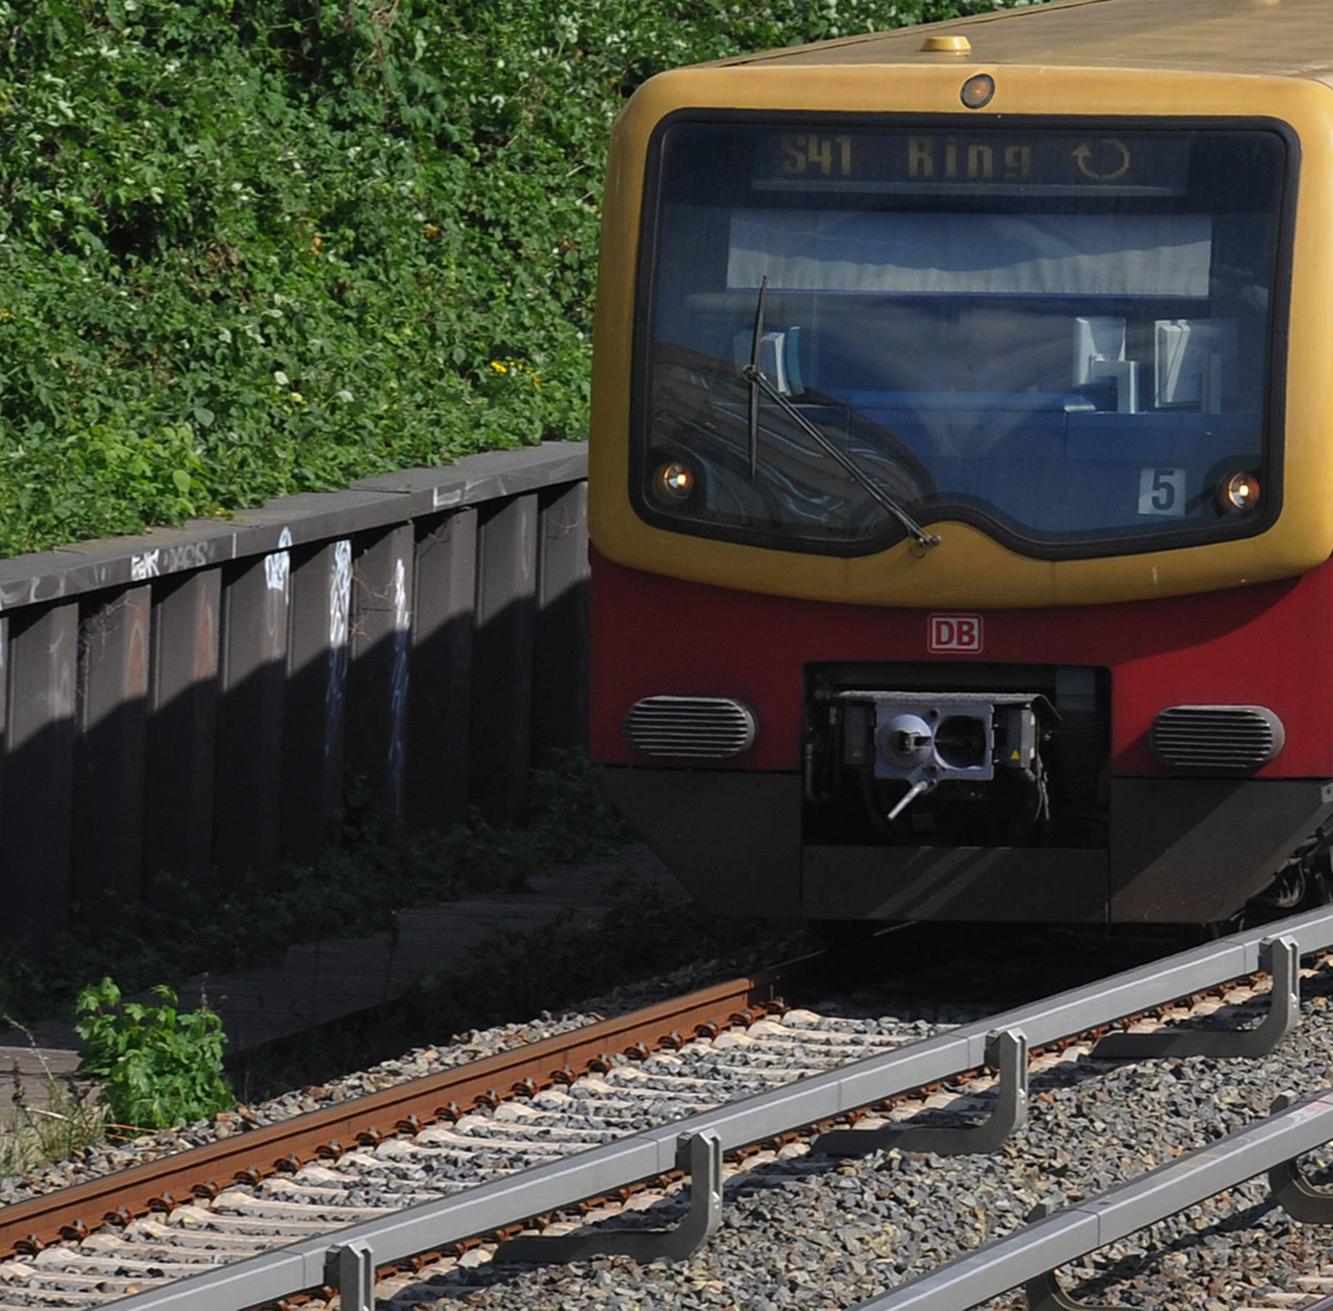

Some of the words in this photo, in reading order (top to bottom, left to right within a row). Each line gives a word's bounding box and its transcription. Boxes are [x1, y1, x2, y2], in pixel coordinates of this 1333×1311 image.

[782, 134, 851, 176] S41
[907, 136, 1032, 179] Ring
[1151, 469, 1175, 511] 5
[934, 619, 977, 647] DB
